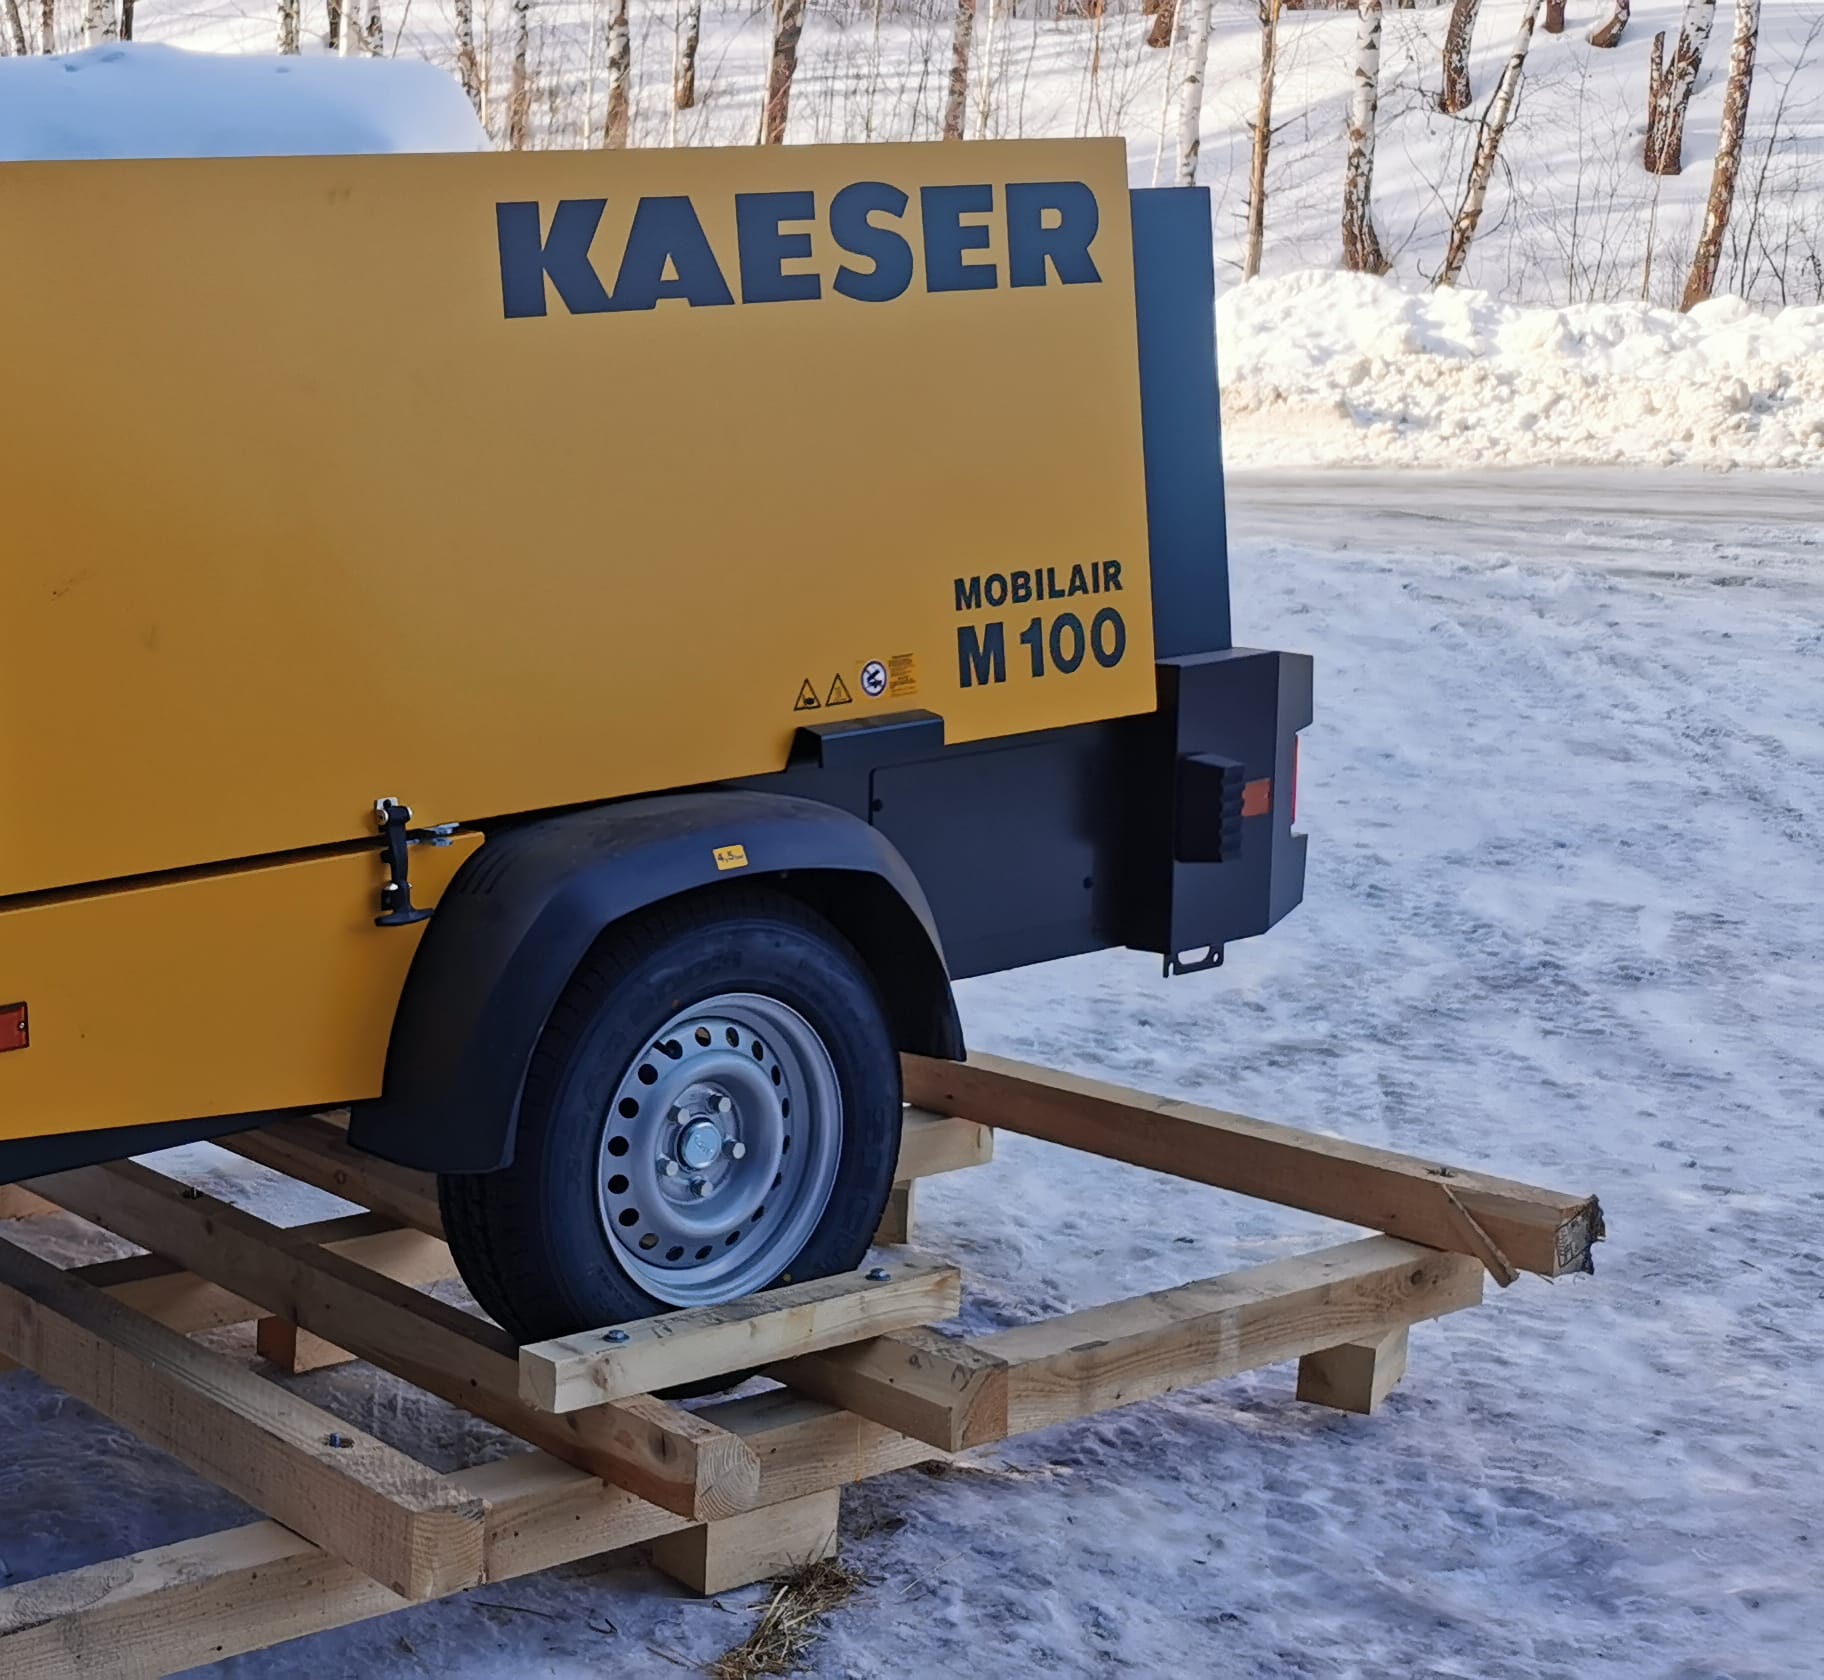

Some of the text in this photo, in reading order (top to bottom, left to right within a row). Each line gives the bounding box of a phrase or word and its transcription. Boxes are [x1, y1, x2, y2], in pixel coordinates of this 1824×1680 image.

[496, 181, 1102, 319] KAESER
[954, 560, 1123, 611] MOBILAIR
[957, 621, 1007, 688] M
[1019, 606, 1127, 678] 100
